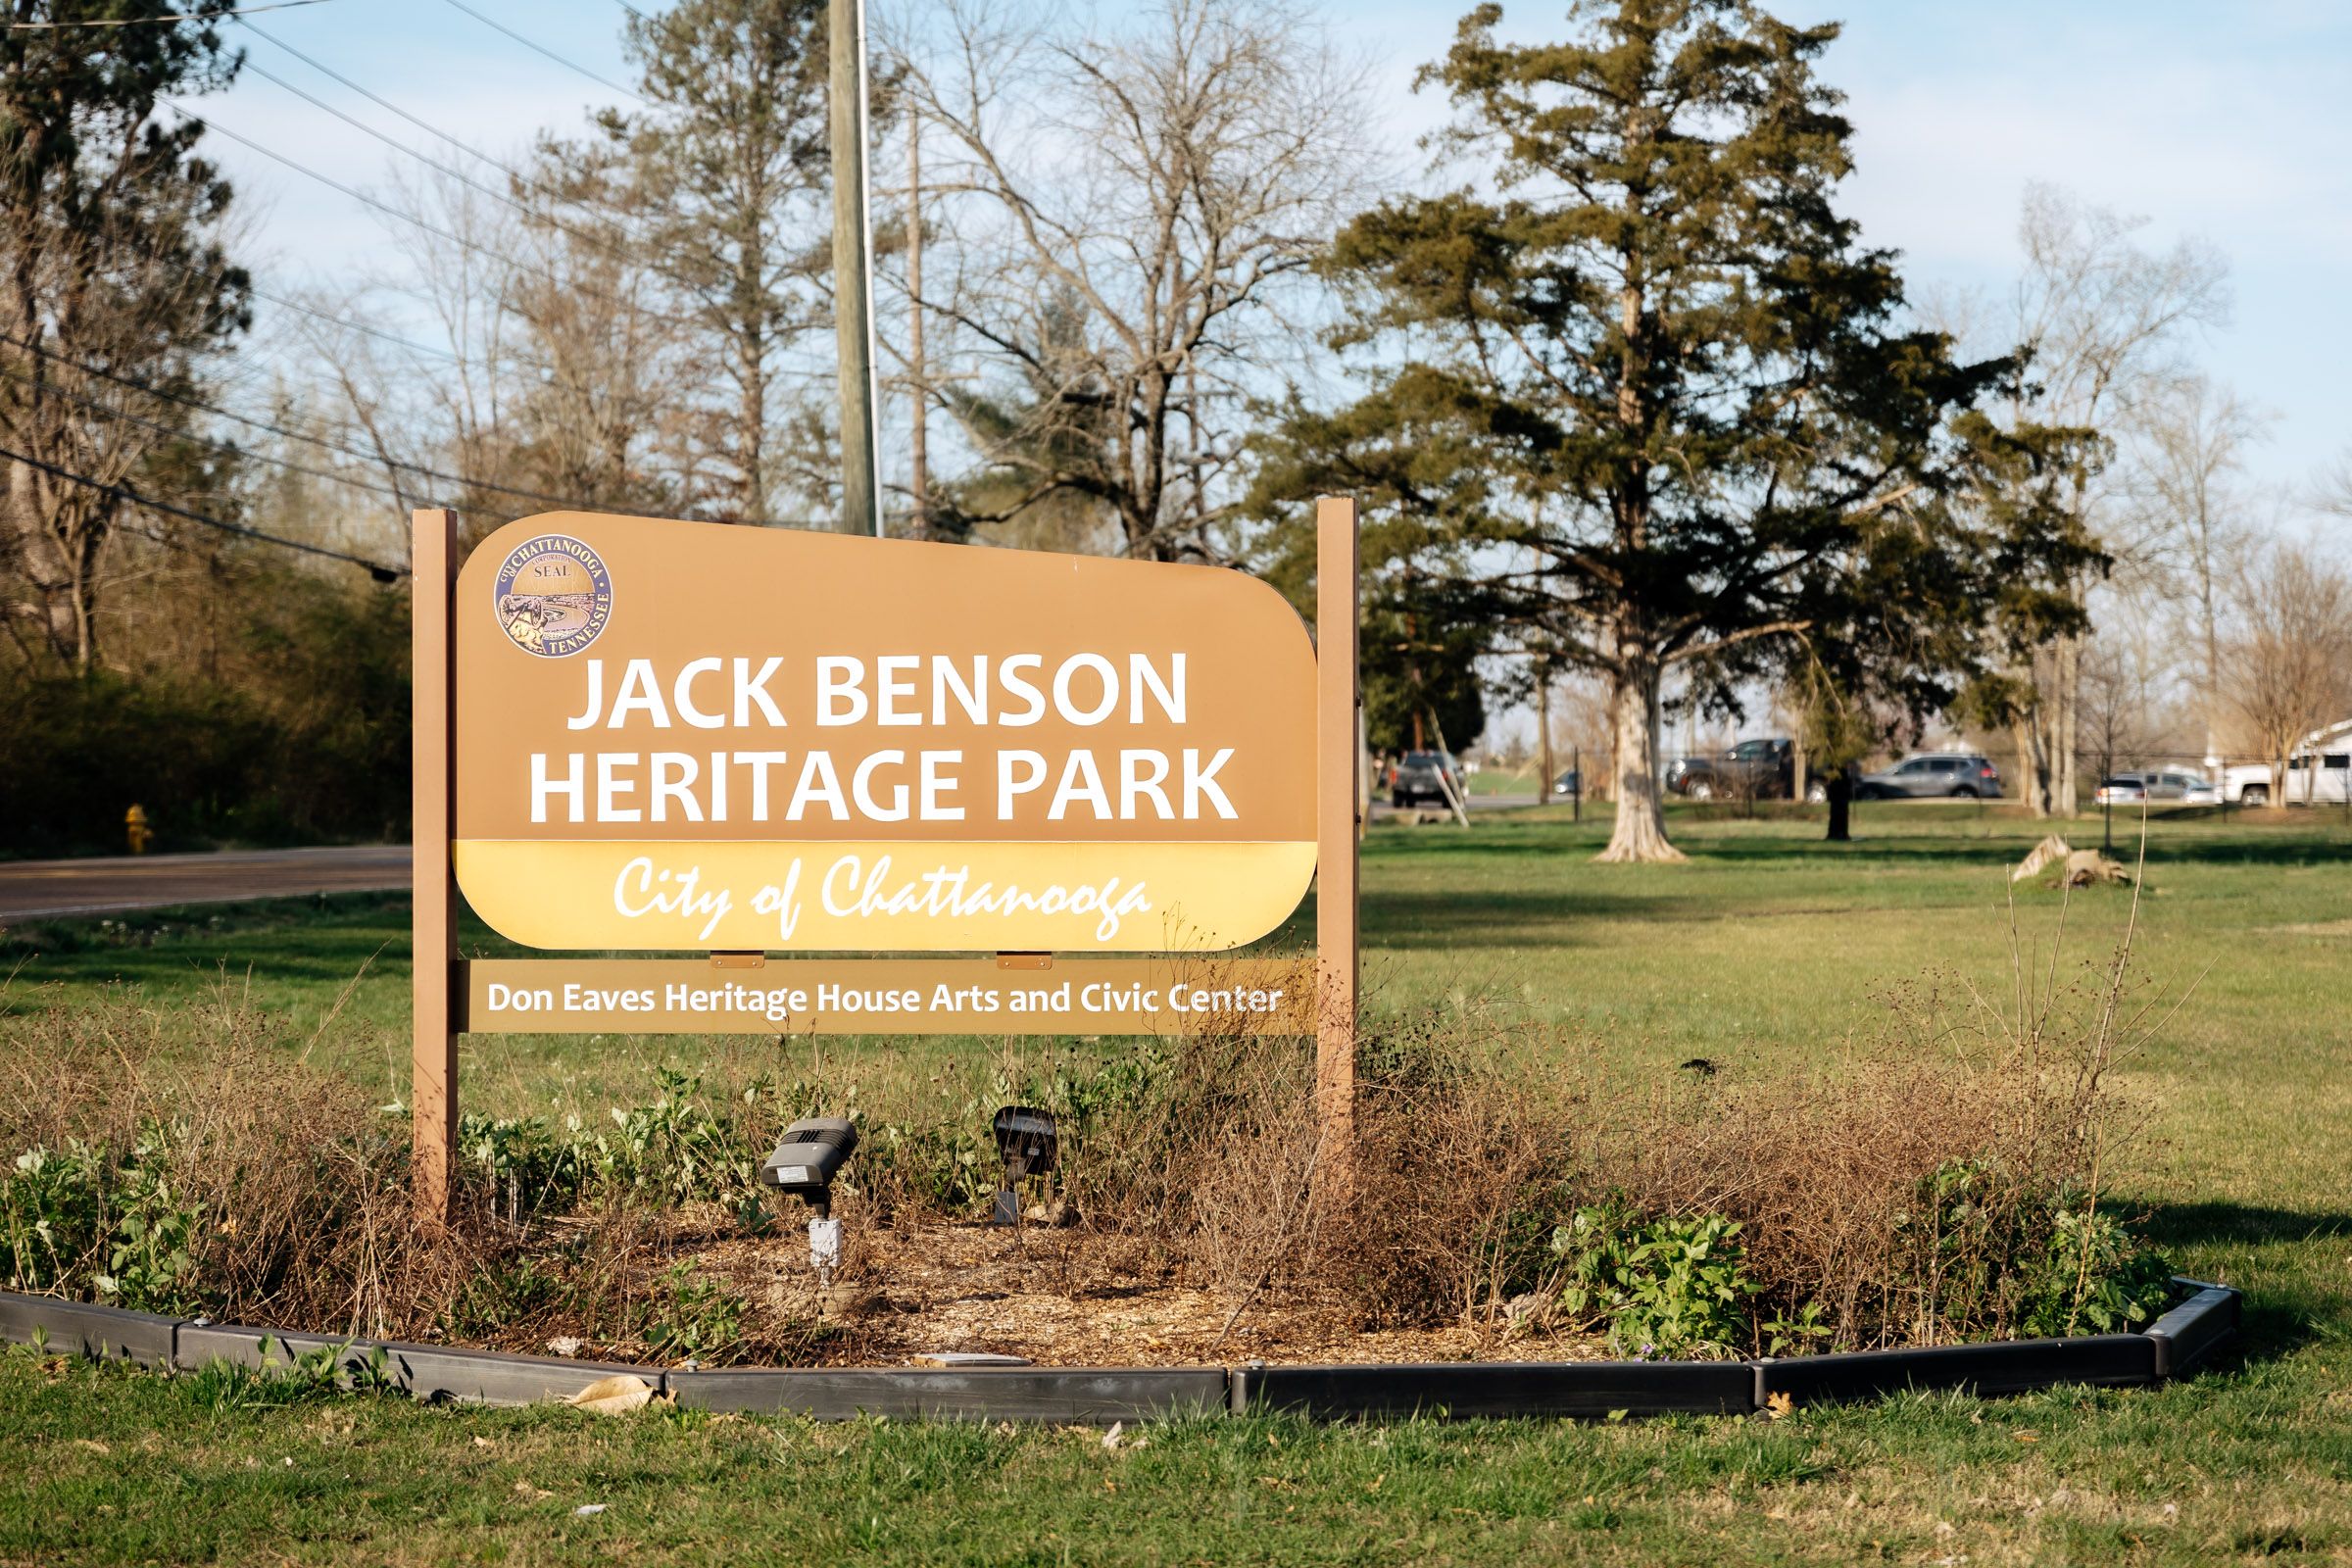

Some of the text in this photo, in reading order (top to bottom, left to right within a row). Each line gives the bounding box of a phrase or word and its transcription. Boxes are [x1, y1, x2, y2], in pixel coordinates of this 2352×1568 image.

[511, 538, 604, 579] CHATTANOOGA
[534, 565, 571, 577] SEAL
[549, 593, 609, 655] TENNESSEE
[566, 653, 1187, 730] JACK BENSON
[529, 748, 1239, 823] HERITAGE PARK
[612, 854, 1153, 940] City of Chattanooga
[488, 982, 1284, 1021] Don Eaves Heritage House Arts and Civic Center
